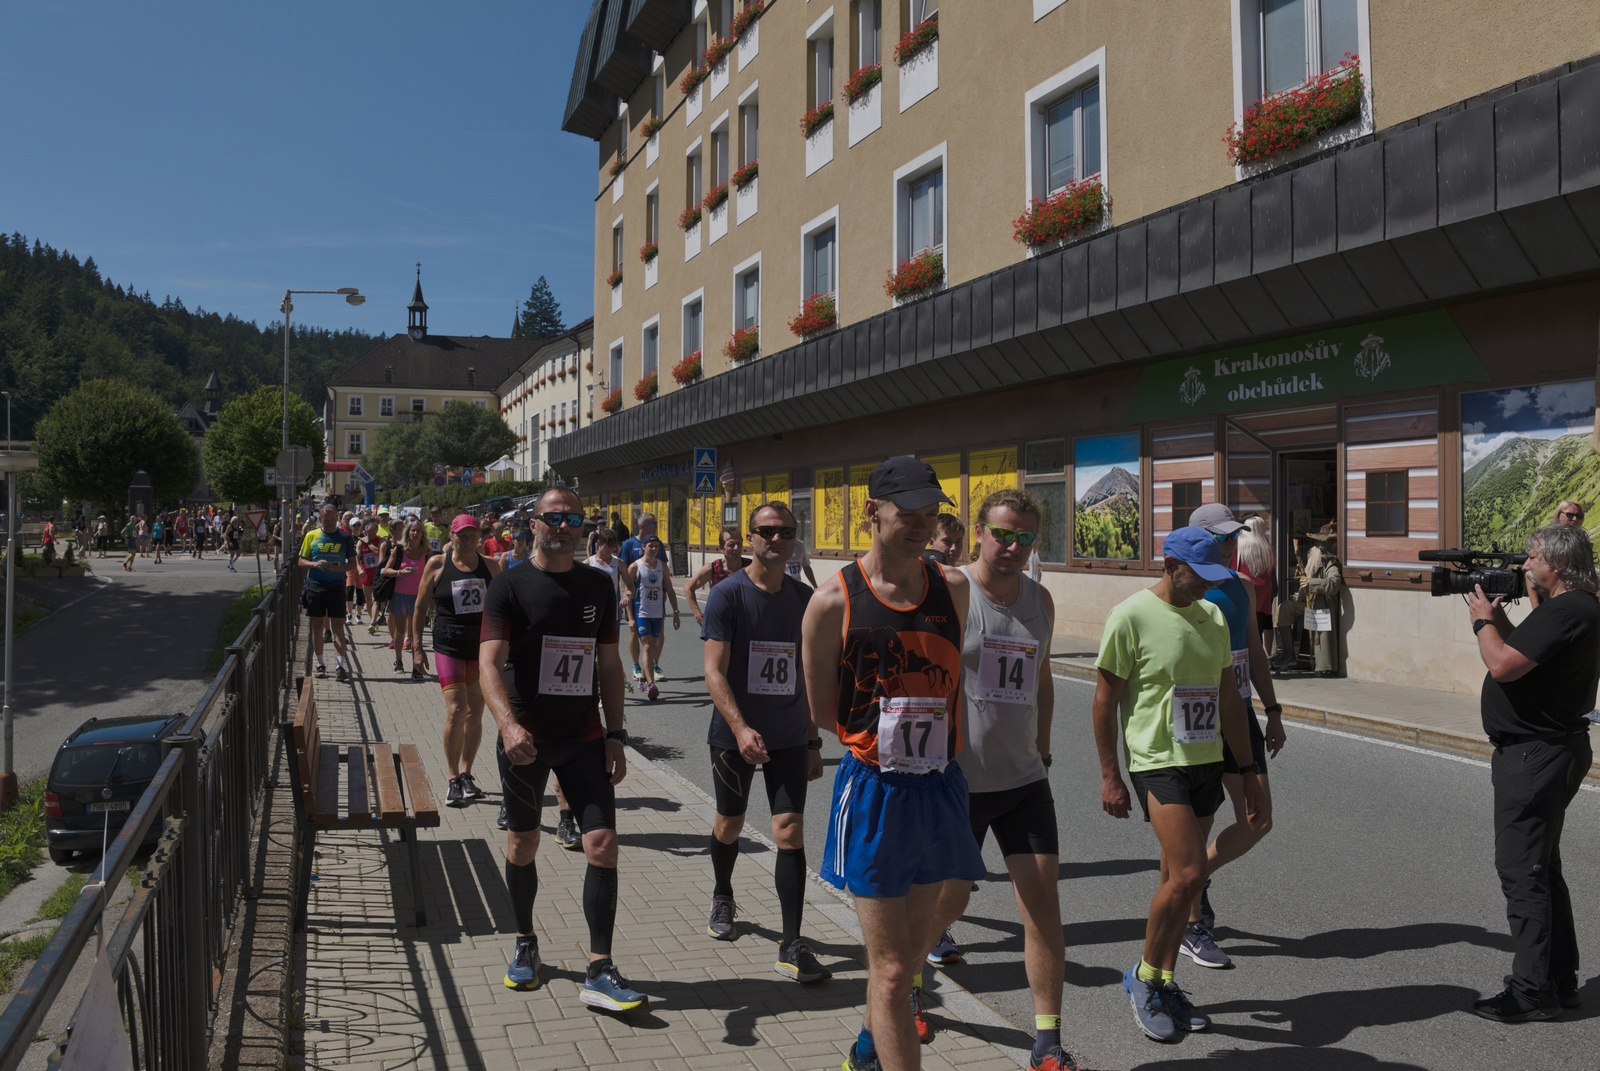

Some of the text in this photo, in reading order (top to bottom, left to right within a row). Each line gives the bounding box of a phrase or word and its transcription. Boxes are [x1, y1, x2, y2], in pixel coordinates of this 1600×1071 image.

[1213, 339, 1343, 377] Krakonošův
[1227, 372, 1325, 402] obchůdek
[640, 463, 677, 482] CUKRÁRNA
[367, 557, 376, 565] 69
[789, 564, 801, 574] 137
[461, 588, 482, 607] 23
[647, 590, 659, 601] 45
[925, 615, 948, 623] ATEX
[553, 655, 584, 684] 47
[760, 657, 789, 684] 48
[998, 656, 1024, 690] 14
[1234, 663, 1248, 689] 84
[1182, 702, 1216, 731] 122
[901, 721, 933, 758] 17
[110, 802, 127, 810] 4895
